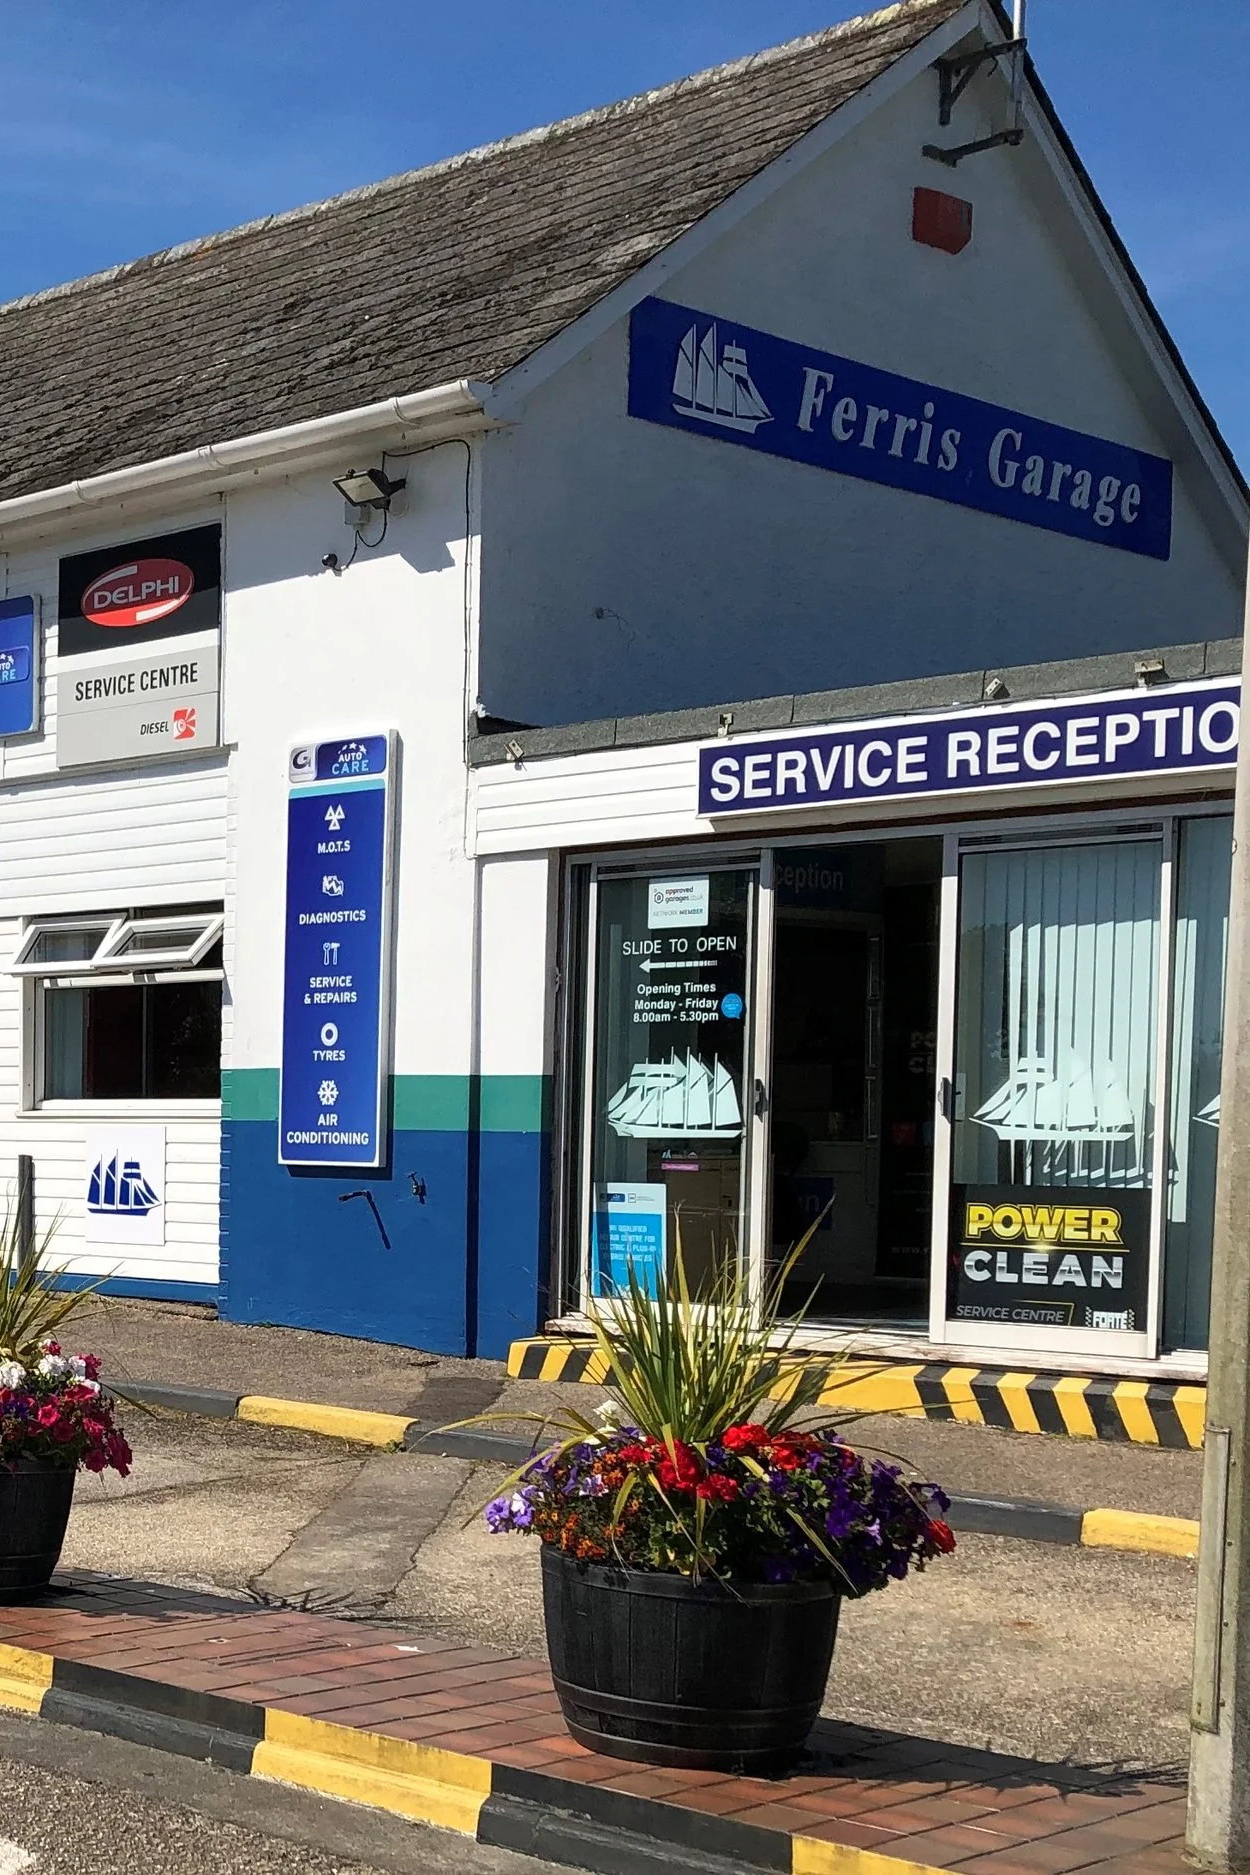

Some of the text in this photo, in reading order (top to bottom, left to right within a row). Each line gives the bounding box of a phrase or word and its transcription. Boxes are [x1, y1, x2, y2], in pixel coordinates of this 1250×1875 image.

[796, 367, 1141, 527] Ferris Garage
[93, 576, 179, 609] DELPHI
[75, 662, 198, 702] SERVICE CENTRE
[140, 721, 169, 735] DIESEL
[338, 752, 362, 763] AUTO
[331, 760, 370, 775] CARE
[711, 736, 928, 802] SERVICE
[318, 840, 351, 854] M.O.T.S
[665, 886, 694, 896] approved
[299, 910, 366, 925] DIAGNOSTICS
[622, 936, 737, 955] SLIDE TO OPEN
[310, 975, 353, 988] SERVICE
[637, 982, 716, 996] Opening Times
[304, 992, 357, 1004] & REPAIRS
[634, 999, 676, 1012] Monday
[686, 998, 718, 1011] Friday
[633, 1012, 670, 1023] 8.00am
[680, 1011, 719, 1024] 5.30pm
[313, 1050, 346, 1061] TYRES
[318, 1114, 338, 1126] AIR
[287, 1132, 369, 1145] CONDITIONING
[967, 1204, 1121, 1242] POWER
[964, 1250, 1123, 1288] CLEAN
[956, 1305, 1065, 1323] SERVICE CENTRE
